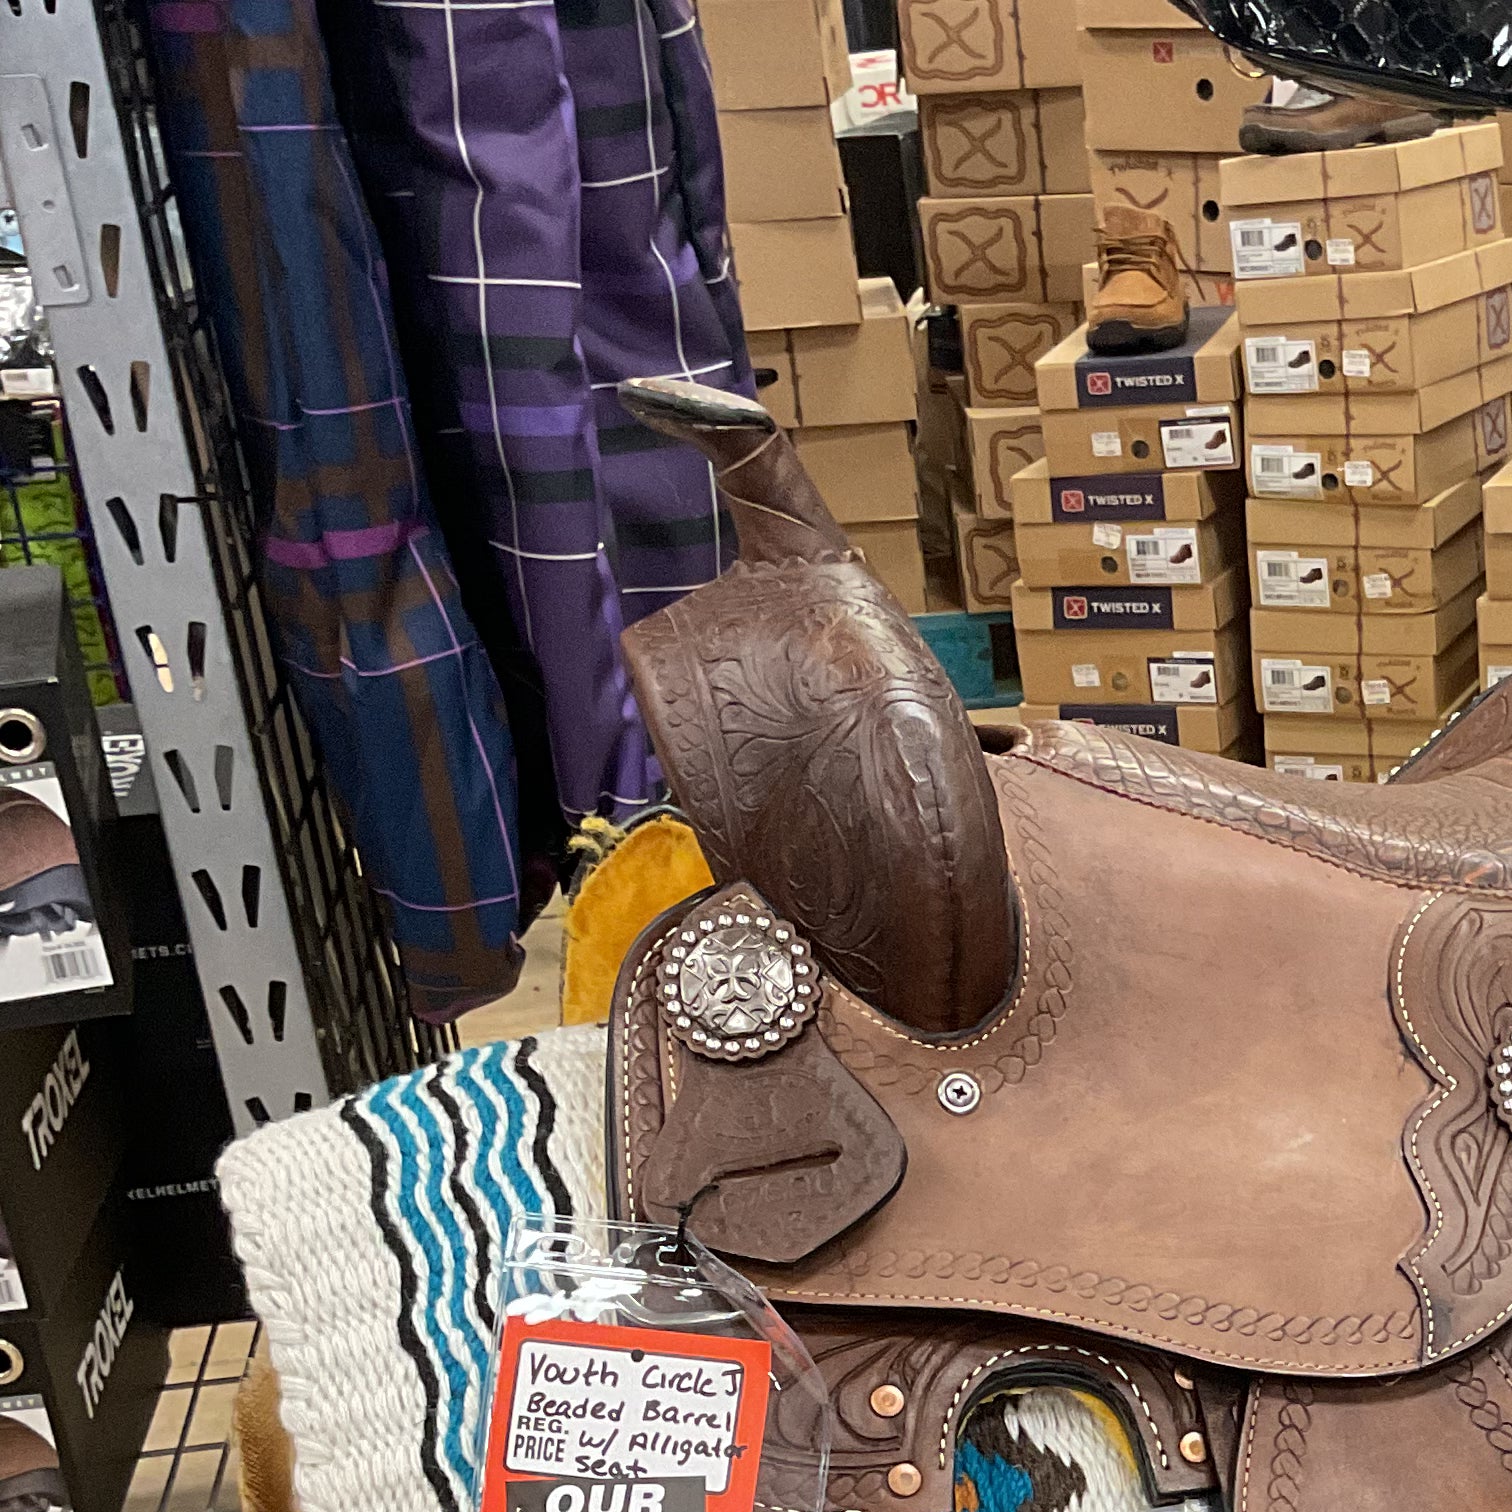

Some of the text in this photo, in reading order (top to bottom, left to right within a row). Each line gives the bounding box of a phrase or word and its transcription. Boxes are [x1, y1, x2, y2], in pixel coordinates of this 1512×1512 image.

[1115, 374, 1185, 388] TWISTED X
[1087, 494, 1154, 506] TWISTED X
[1091, 602, 1162, 614] TWISTED X
[22, 1027, 91, 1171] TROXEL
[76, 1269, 135, 1420] TROXEL
[529, 1352, 745, 1397] Youth Circle J
[516, 1415, 570, 1435] REG.
[526, 1391, 732, 1432] Beaded Barrel
[512, 1434, 566, 1463] PRICE
[578, 1428, 749, 1467] w/ Alligator
